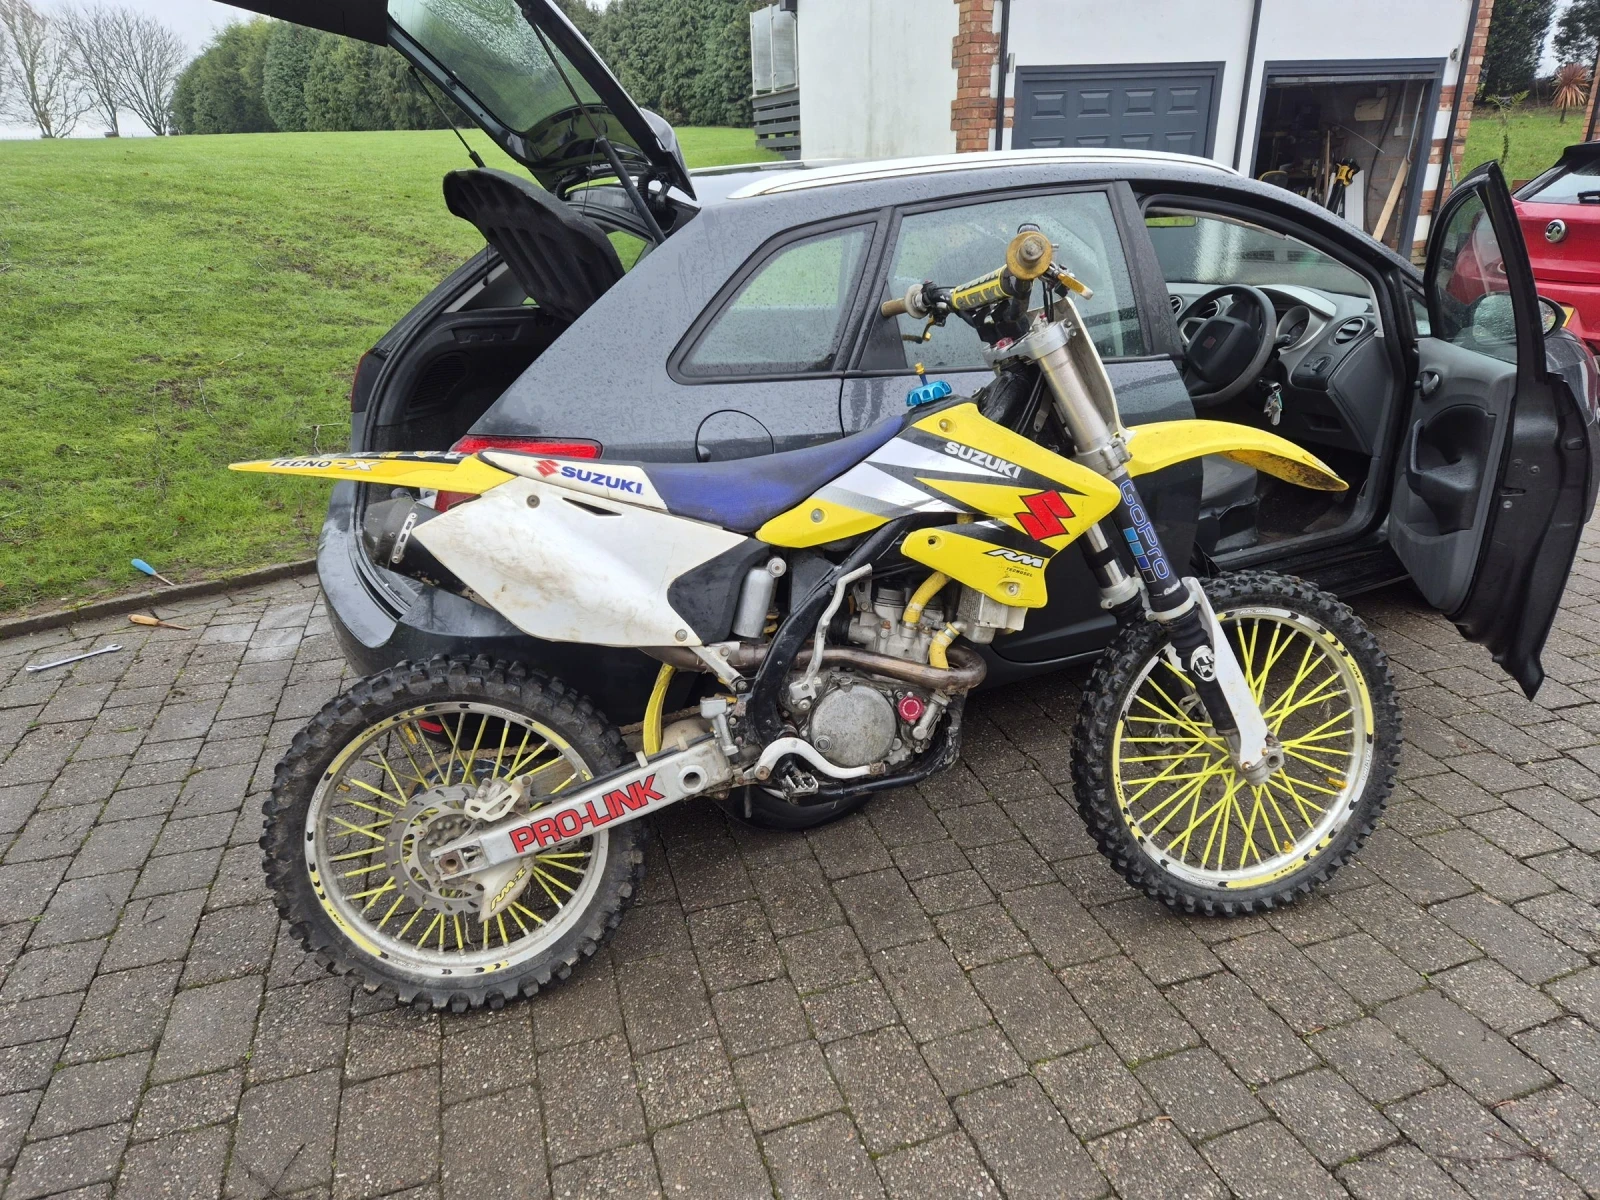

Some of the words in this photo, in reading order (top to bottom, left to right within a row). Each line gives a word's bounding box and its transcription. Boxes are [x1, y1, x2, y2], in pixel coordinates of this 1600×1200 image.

[944, 441, 1021, 479] SUZUKI
[560, 466, 643, 495] SUZUKI
[983, 548, 1044, 569] RM
[509, 773, 665, 853] PRO-LINK
